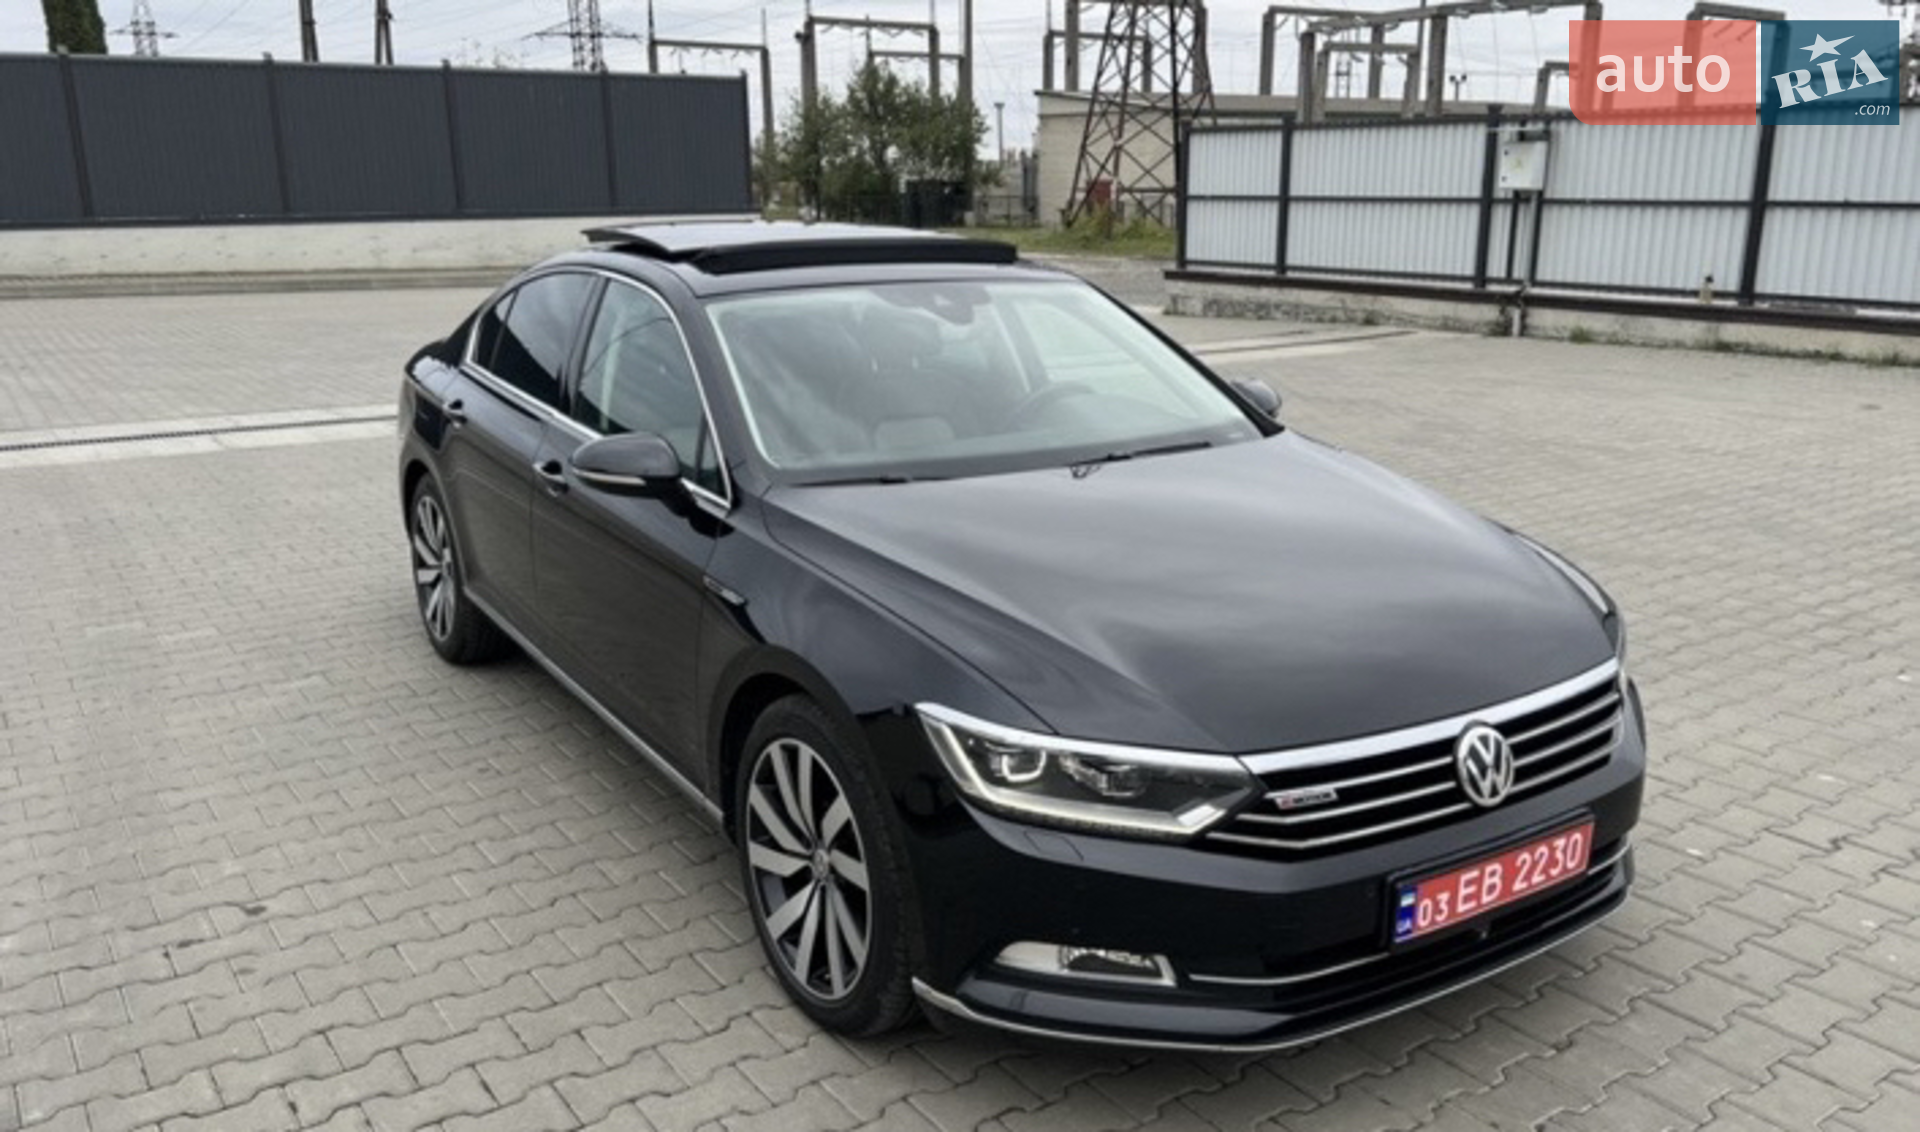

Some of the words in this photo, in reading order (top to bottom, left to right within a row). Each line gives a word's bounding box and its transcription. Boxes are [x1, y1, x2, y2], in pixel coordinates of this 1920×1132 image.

[1417, 892, 1451, 927] 03
[1457, 863, 1503, 913] EB
[1512, 832, 1583, 892] 2230
